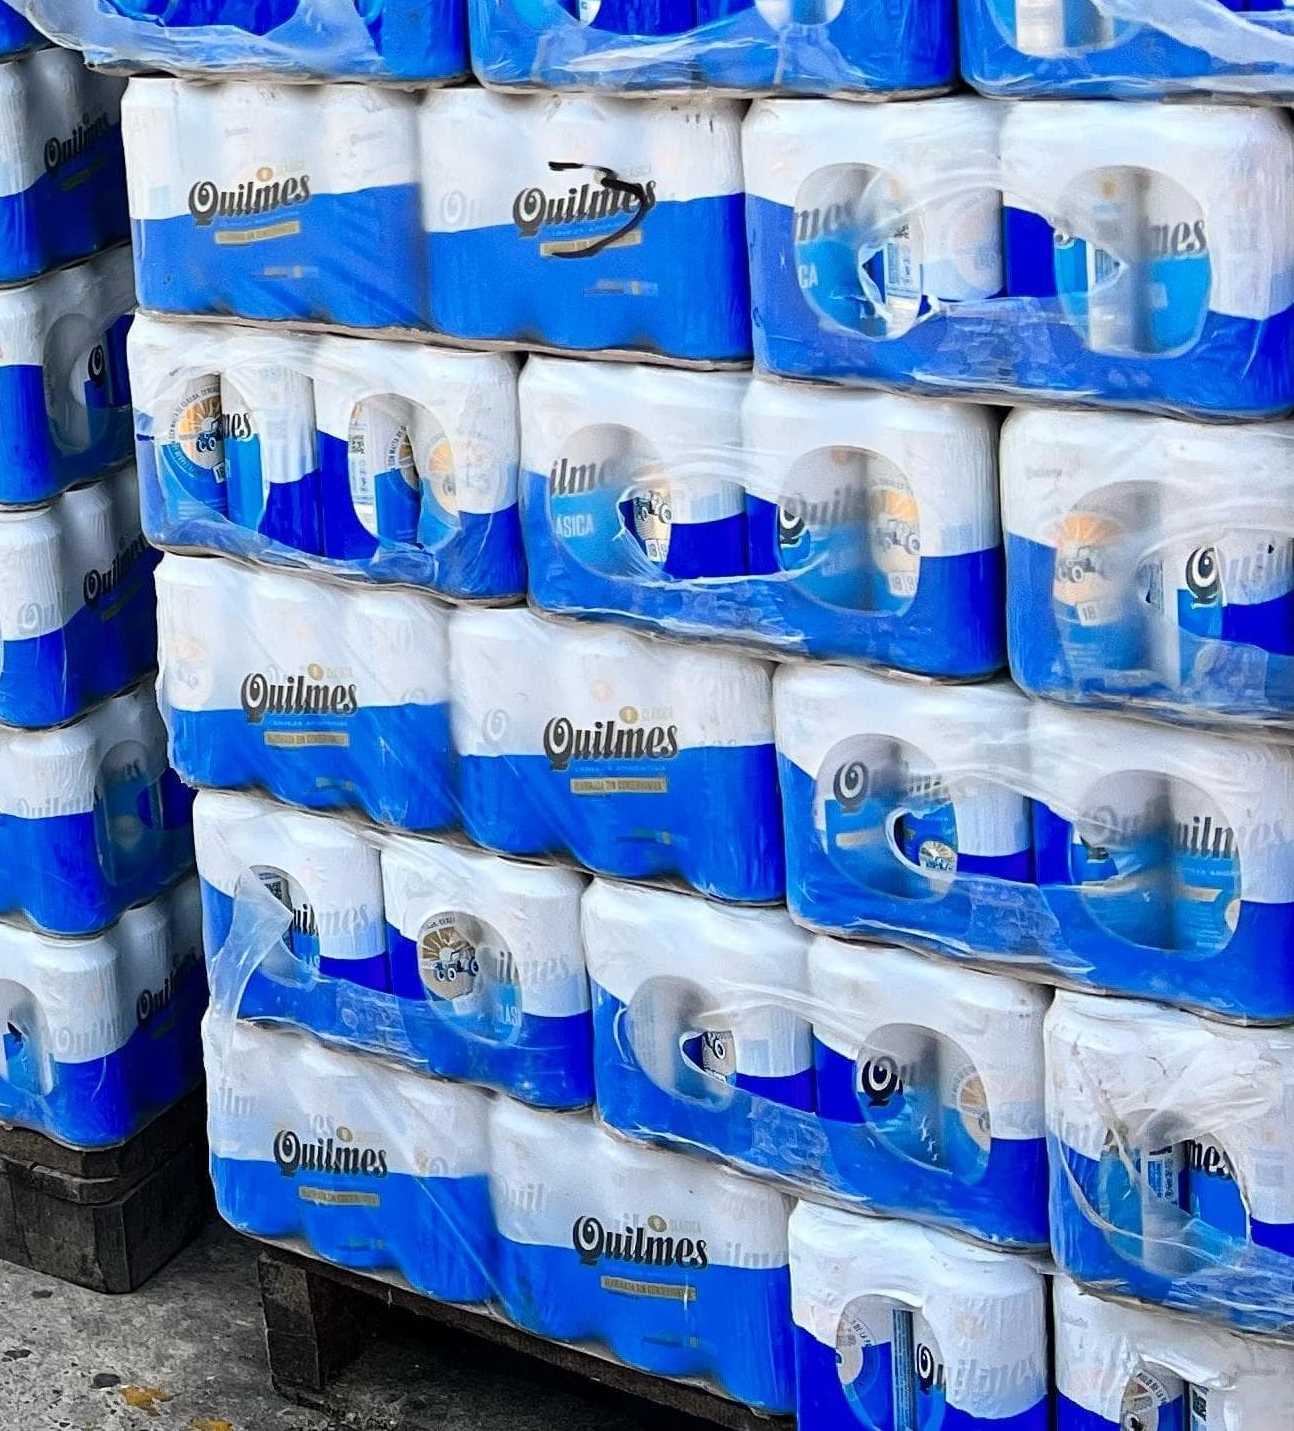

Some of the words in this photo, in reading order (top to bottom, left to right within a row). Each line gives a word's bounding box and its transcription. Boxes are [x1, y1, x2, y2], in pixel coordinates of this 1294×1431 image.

[188, 174, 311, 227] Quilmes
[513, 179, 656, 239] Quilmes
[241, 672, 358, 724] Quilmes
[543, 716, 678, 771] Quilmes
[273, 1128, 388, 1179] Quilmes
[573, 1215, 709, 1270] Quilmes
